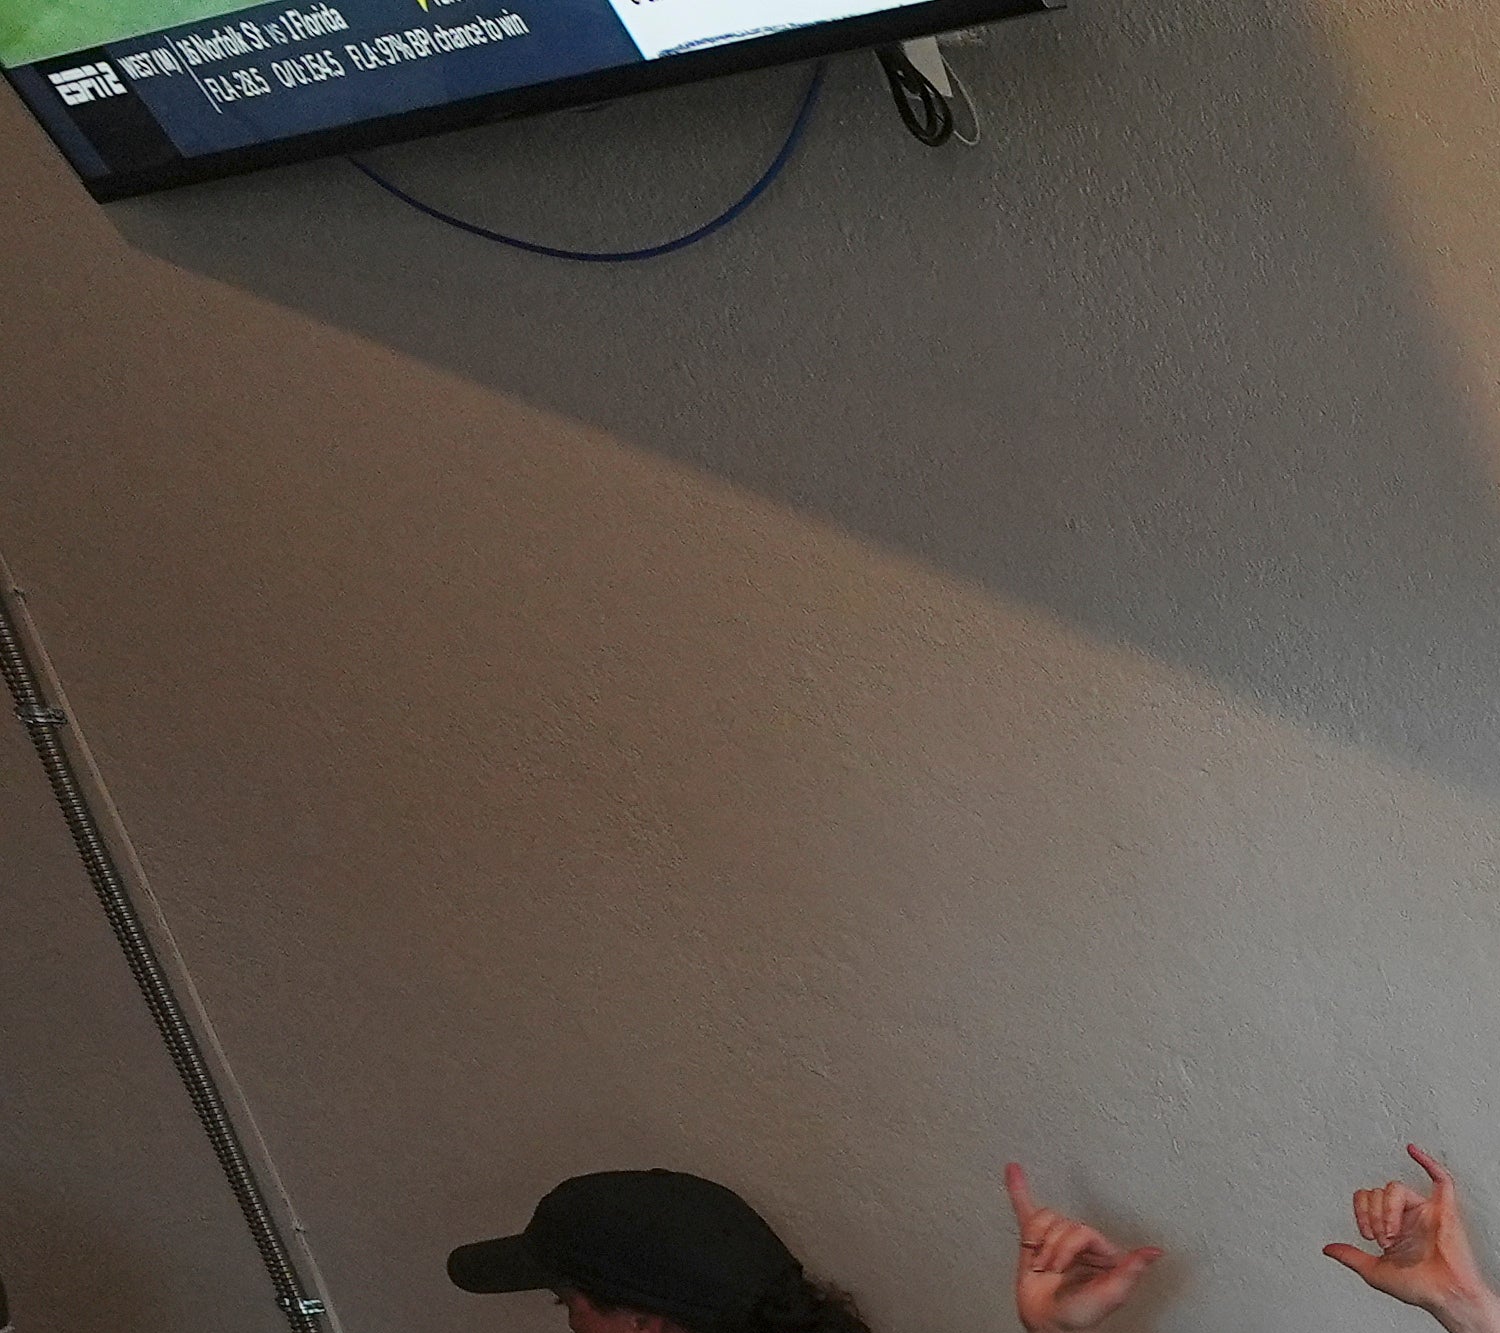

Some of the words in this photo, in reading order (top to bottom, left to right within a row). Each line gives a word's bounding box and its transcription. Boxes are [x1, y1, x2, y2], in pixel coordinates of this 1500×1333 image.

[189, 24, 253, 64] Norfolk
[238, 20, 271, 51] St
[261, 20, 289, 45] vs
[285, 0, 349, 39] Florida
[427, 14, 489, 54] chance
[477, 16, 505, 42] to
[490, 6, 529, 38] win
